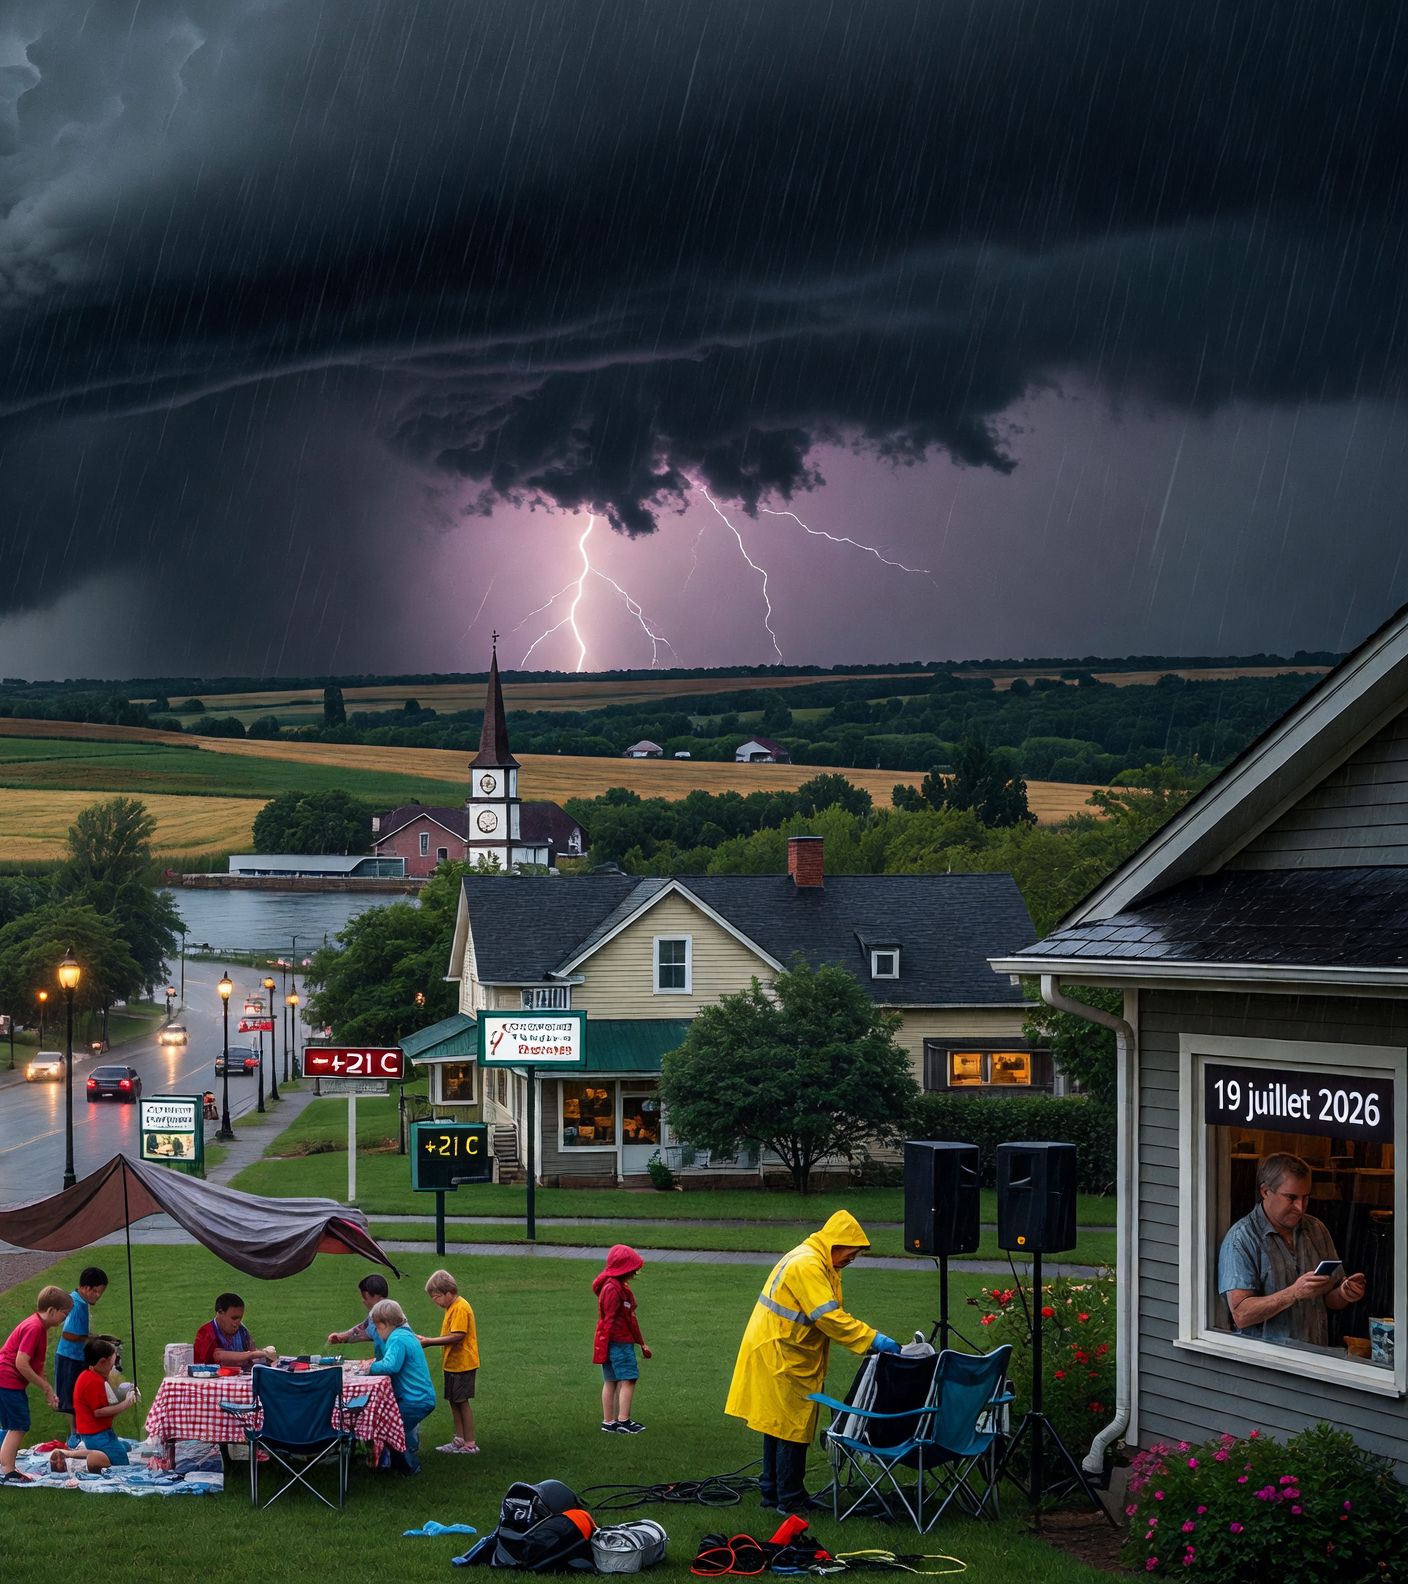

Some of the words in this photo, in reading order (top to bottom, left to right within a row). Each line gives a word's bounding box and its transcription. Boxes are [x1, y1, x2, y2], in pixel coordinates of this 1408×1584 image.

[380, 1053, 398, 1073] C
[1214, 1079, 1241, 1111] 19
[1245, 1082, 1311, 1122] juillet
[1318, 1088, 1381, 1127] 2026
[425, 1135, 459, 1157] +21
[465, 1135, 479, 1155] C
